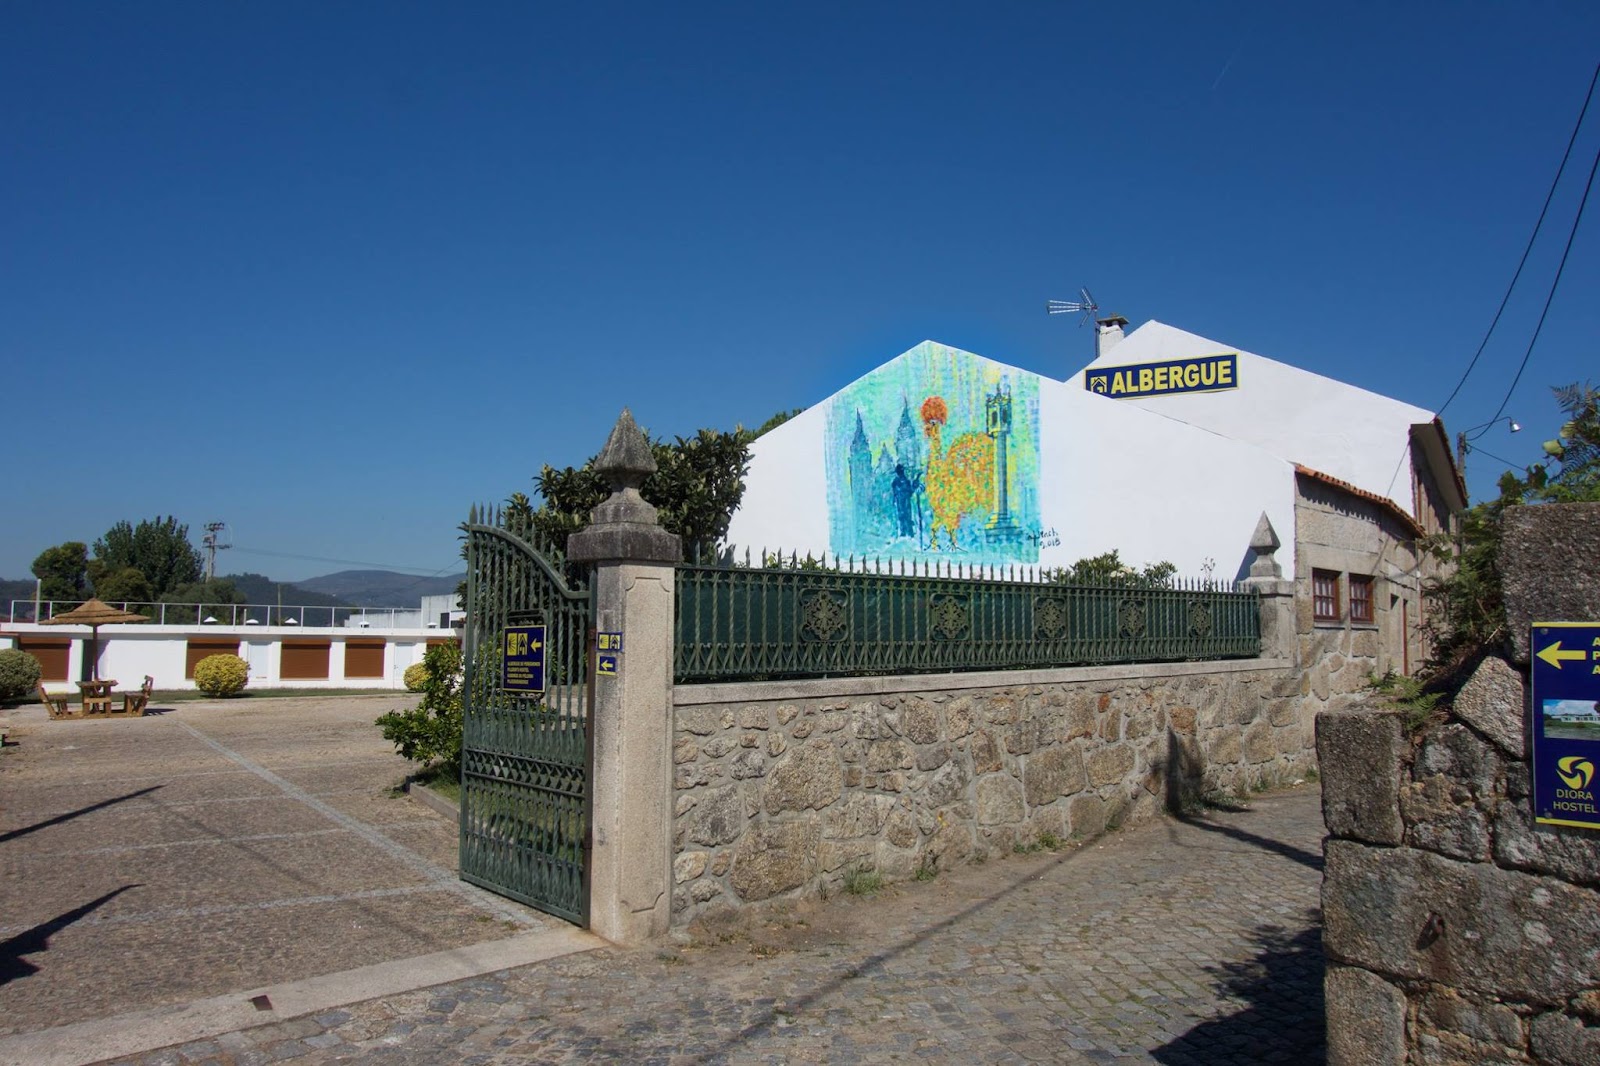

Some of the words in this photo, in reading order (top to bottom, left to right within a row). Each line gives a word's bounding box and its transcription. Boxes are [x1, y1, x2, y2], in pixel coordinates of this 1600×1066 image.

[1110, 360, 1232, 395] ALBERGUE
[1556, 788, 1594, 800] DIORA
[1553, 800, 1599, 813] HOSTEL
